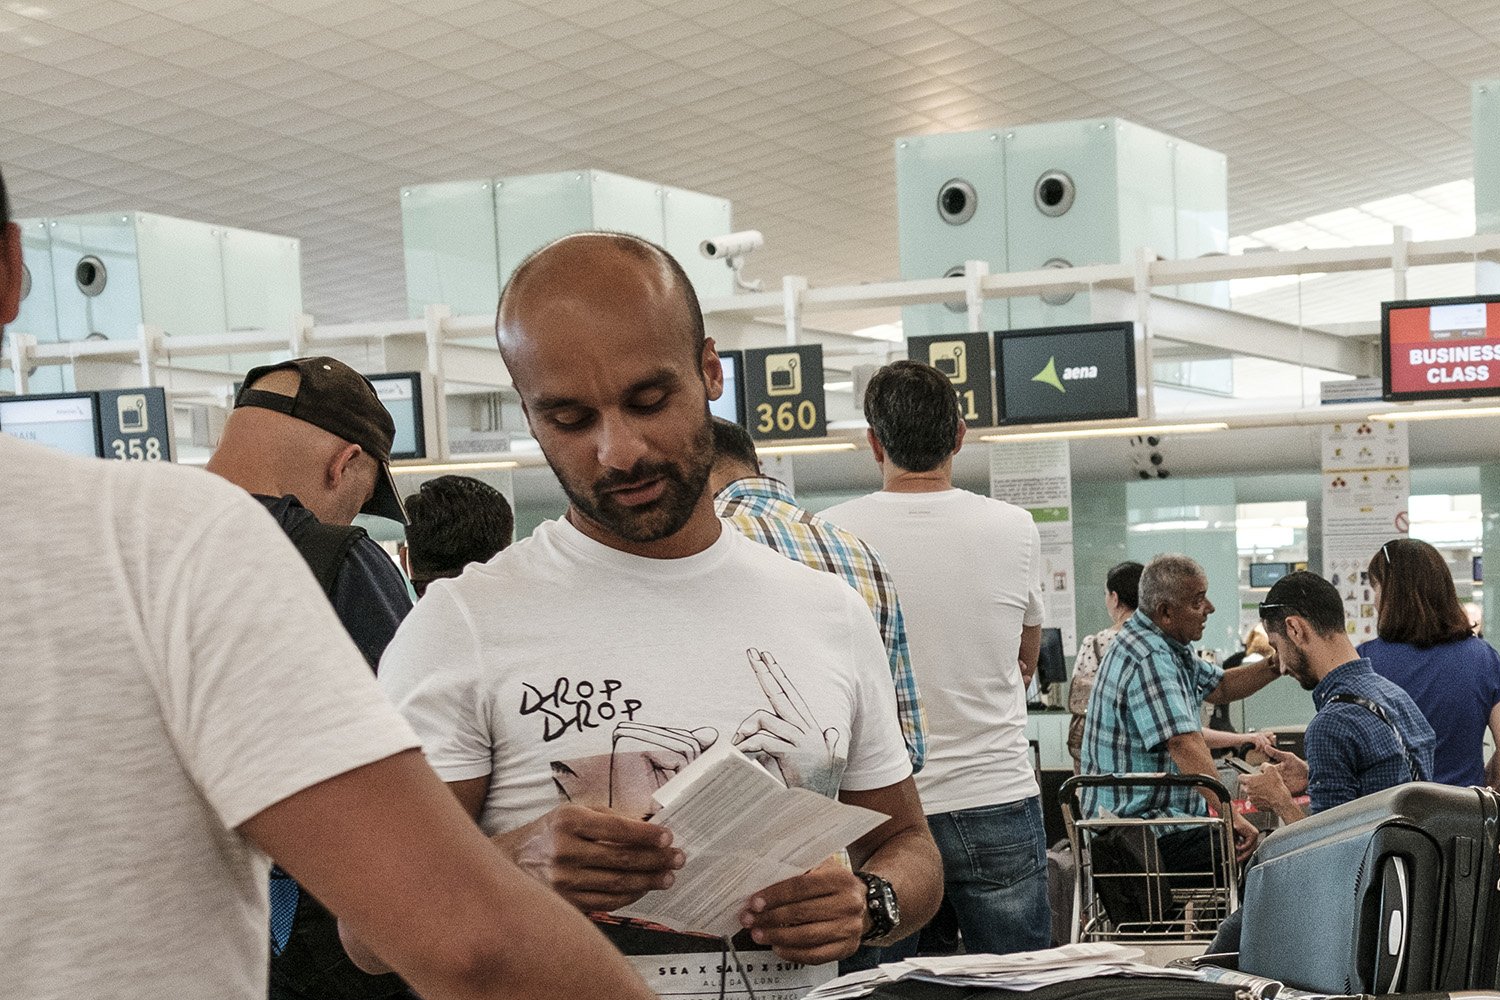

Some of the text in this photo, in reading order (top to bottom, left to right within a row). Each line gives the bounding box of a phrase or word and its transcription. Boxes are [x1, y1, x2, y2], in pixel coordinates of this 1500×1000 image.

[1062, 364, 1098, 381] aena
[1426, 365, 1490, 384] CLASS
[756, 400, 817, 433] 360
[112, 436, 162, 463] 358
[519, 677, 622, 715] DROP
[538, 699, 642, 742] DROP
[658, 967, 689, 976] SEA
[699, 966, 706, 974] X
